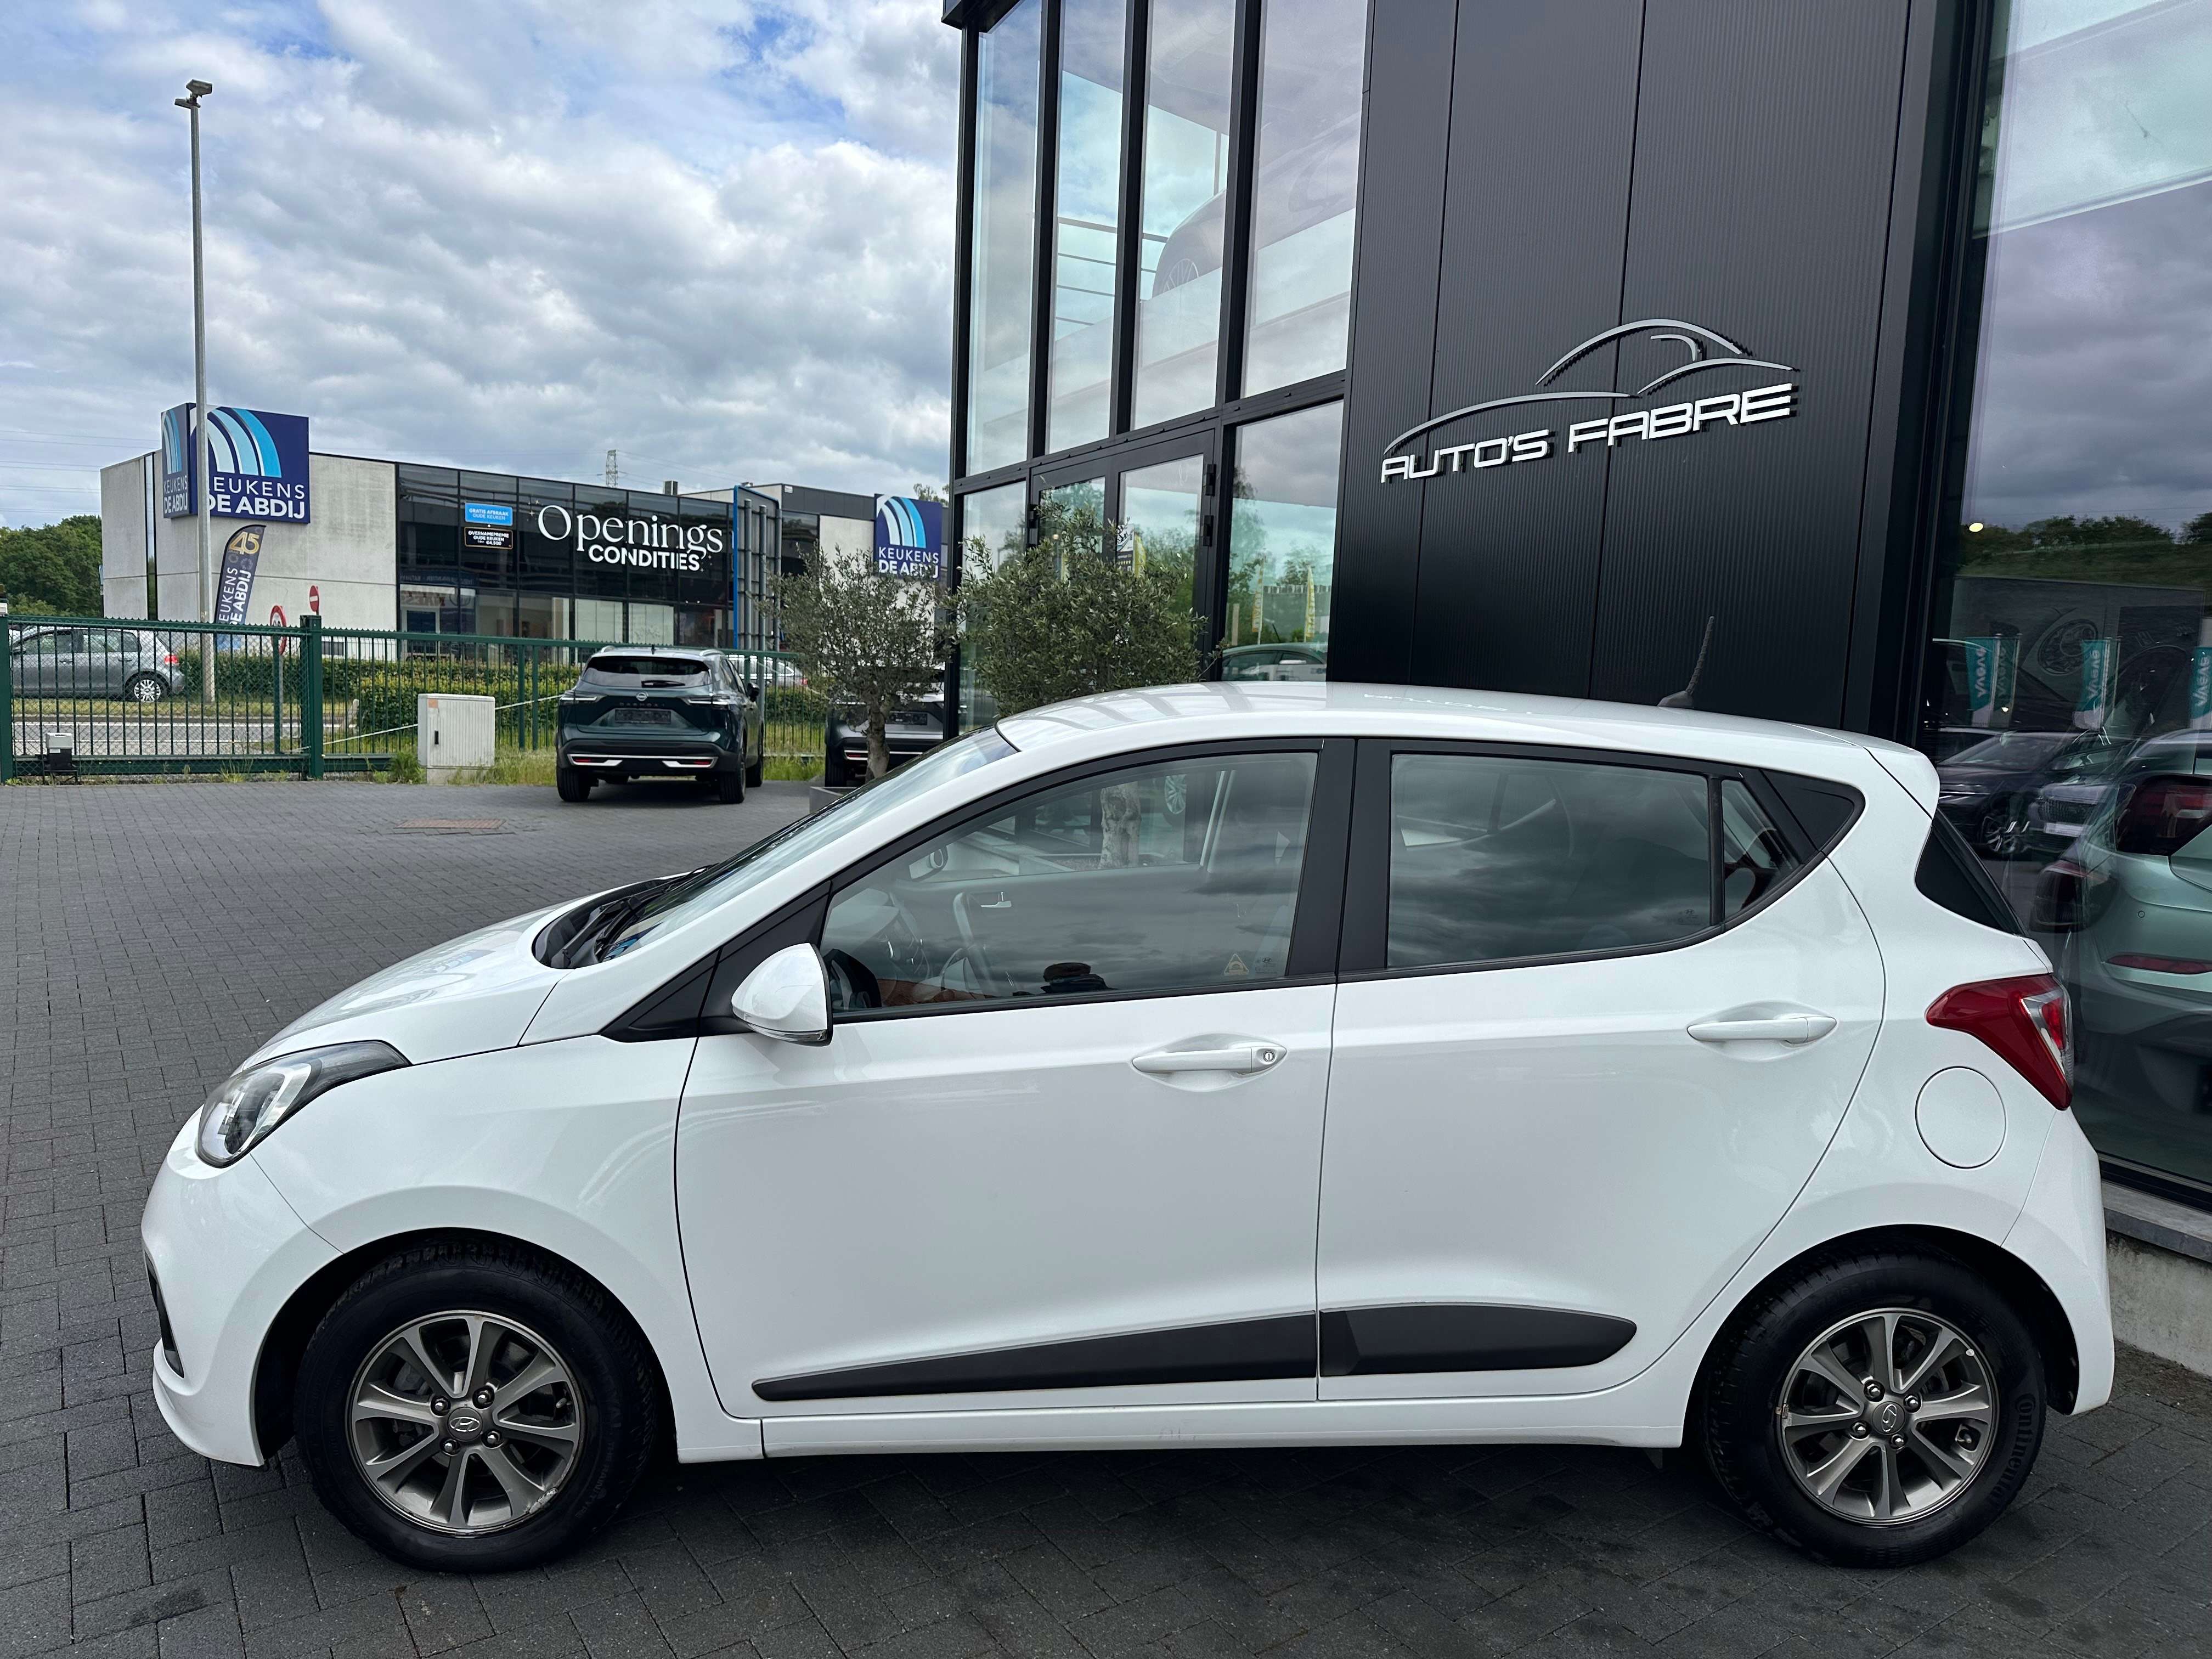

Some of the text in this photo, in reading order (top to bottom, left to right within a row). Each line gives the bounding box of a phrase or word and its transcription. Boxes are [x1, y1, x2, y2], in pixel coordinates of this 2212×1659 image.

[1380, 383, 1792, 483] AUTO'S FABRE
[163, 475, 188, 494] KEUKENS
[208, 476, 304, 500] EUKENS
[163, 493, 188, 514] DE ABDIJ
[235, 496, 305, 519] ABDIJ
[229, 531, 260, 555] 45
[538, 504, 724, 560] Openings
[588, 544, 701, 572] CONDITIES
[878, 546, 939, 564] KEUKENS
[878, 559, 939, 579] DE ABJ
[218, 567, 238, 623] EUKENS
[233, 569, 252, 612] ABDIJ
